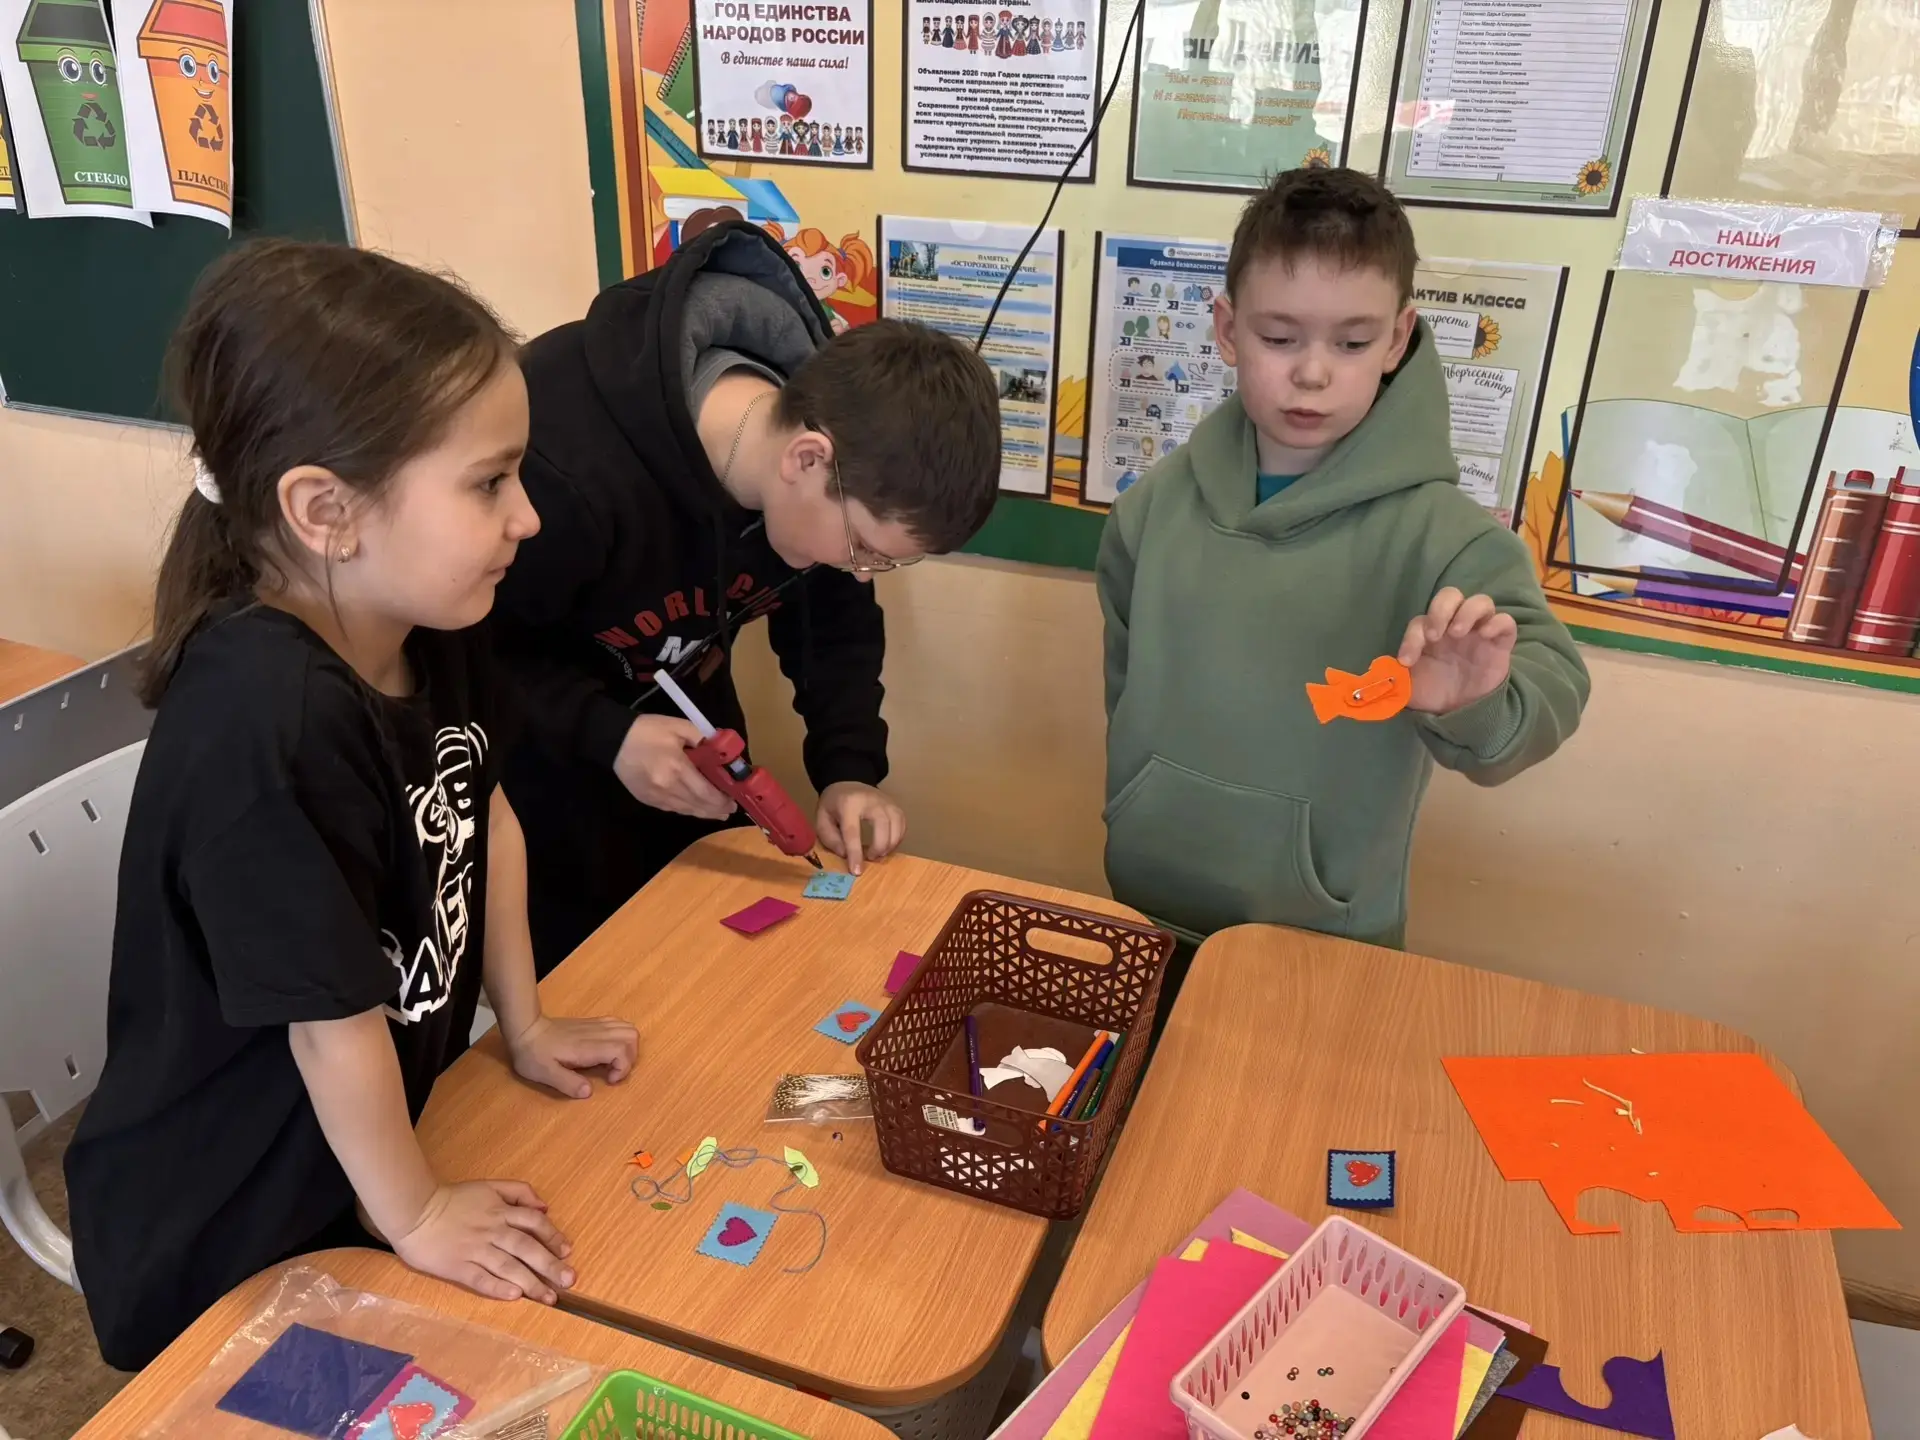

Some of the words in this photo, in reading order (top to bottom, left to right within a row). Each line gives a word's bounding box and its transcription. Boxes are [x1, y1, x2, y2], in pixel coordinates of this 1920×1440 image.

[715, 3, 749, 20] ГОД
[754, 3, 851, 22] ЕДИНСТВА
[703, 25, 786, 44] НАРОДОВ
[792, 28, 864, 45] РОССИИ
[721, 52, 730, 64] В
[734, 51, 783, 66] единстве
[786, 57, 815, 68] наша
[819, 57, 849, 69] сила!
[74, 170, 128, 187] СТЕКЛО
[1717, 229, 1781, 248] НАШИ
[1669, 250, 1816, 275] ДОСТИЖЕНИЯ
[1425, 314, 1471, 328] ароста
[1475, 378, 1512, 399] сектор
